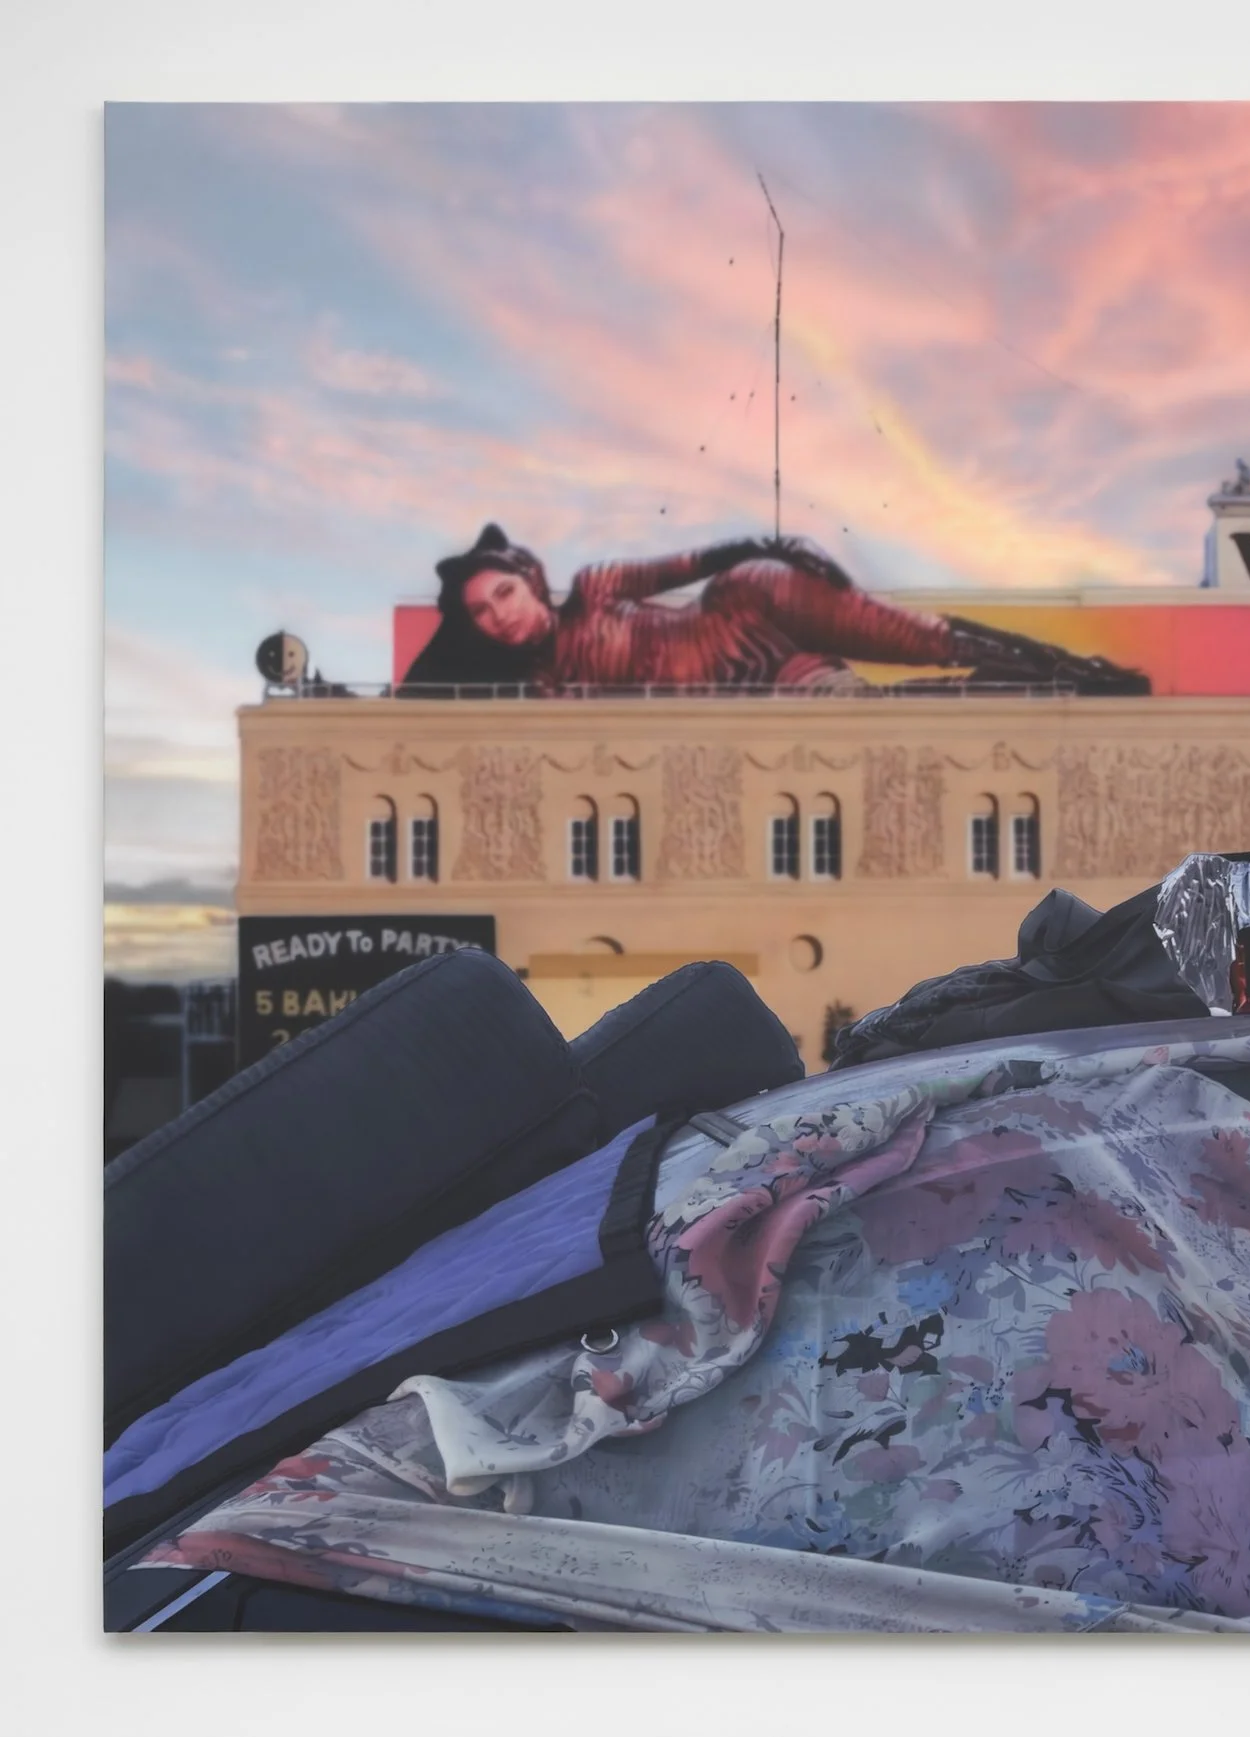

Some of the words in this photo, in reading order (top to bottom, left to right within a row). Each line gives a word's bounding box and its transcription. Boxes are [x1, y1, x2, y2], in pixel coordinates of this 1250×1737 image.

[252, 931, 342, 969] READY
[381, 928, 482, 957] PART
[255, 990, 273, 1016] 5
